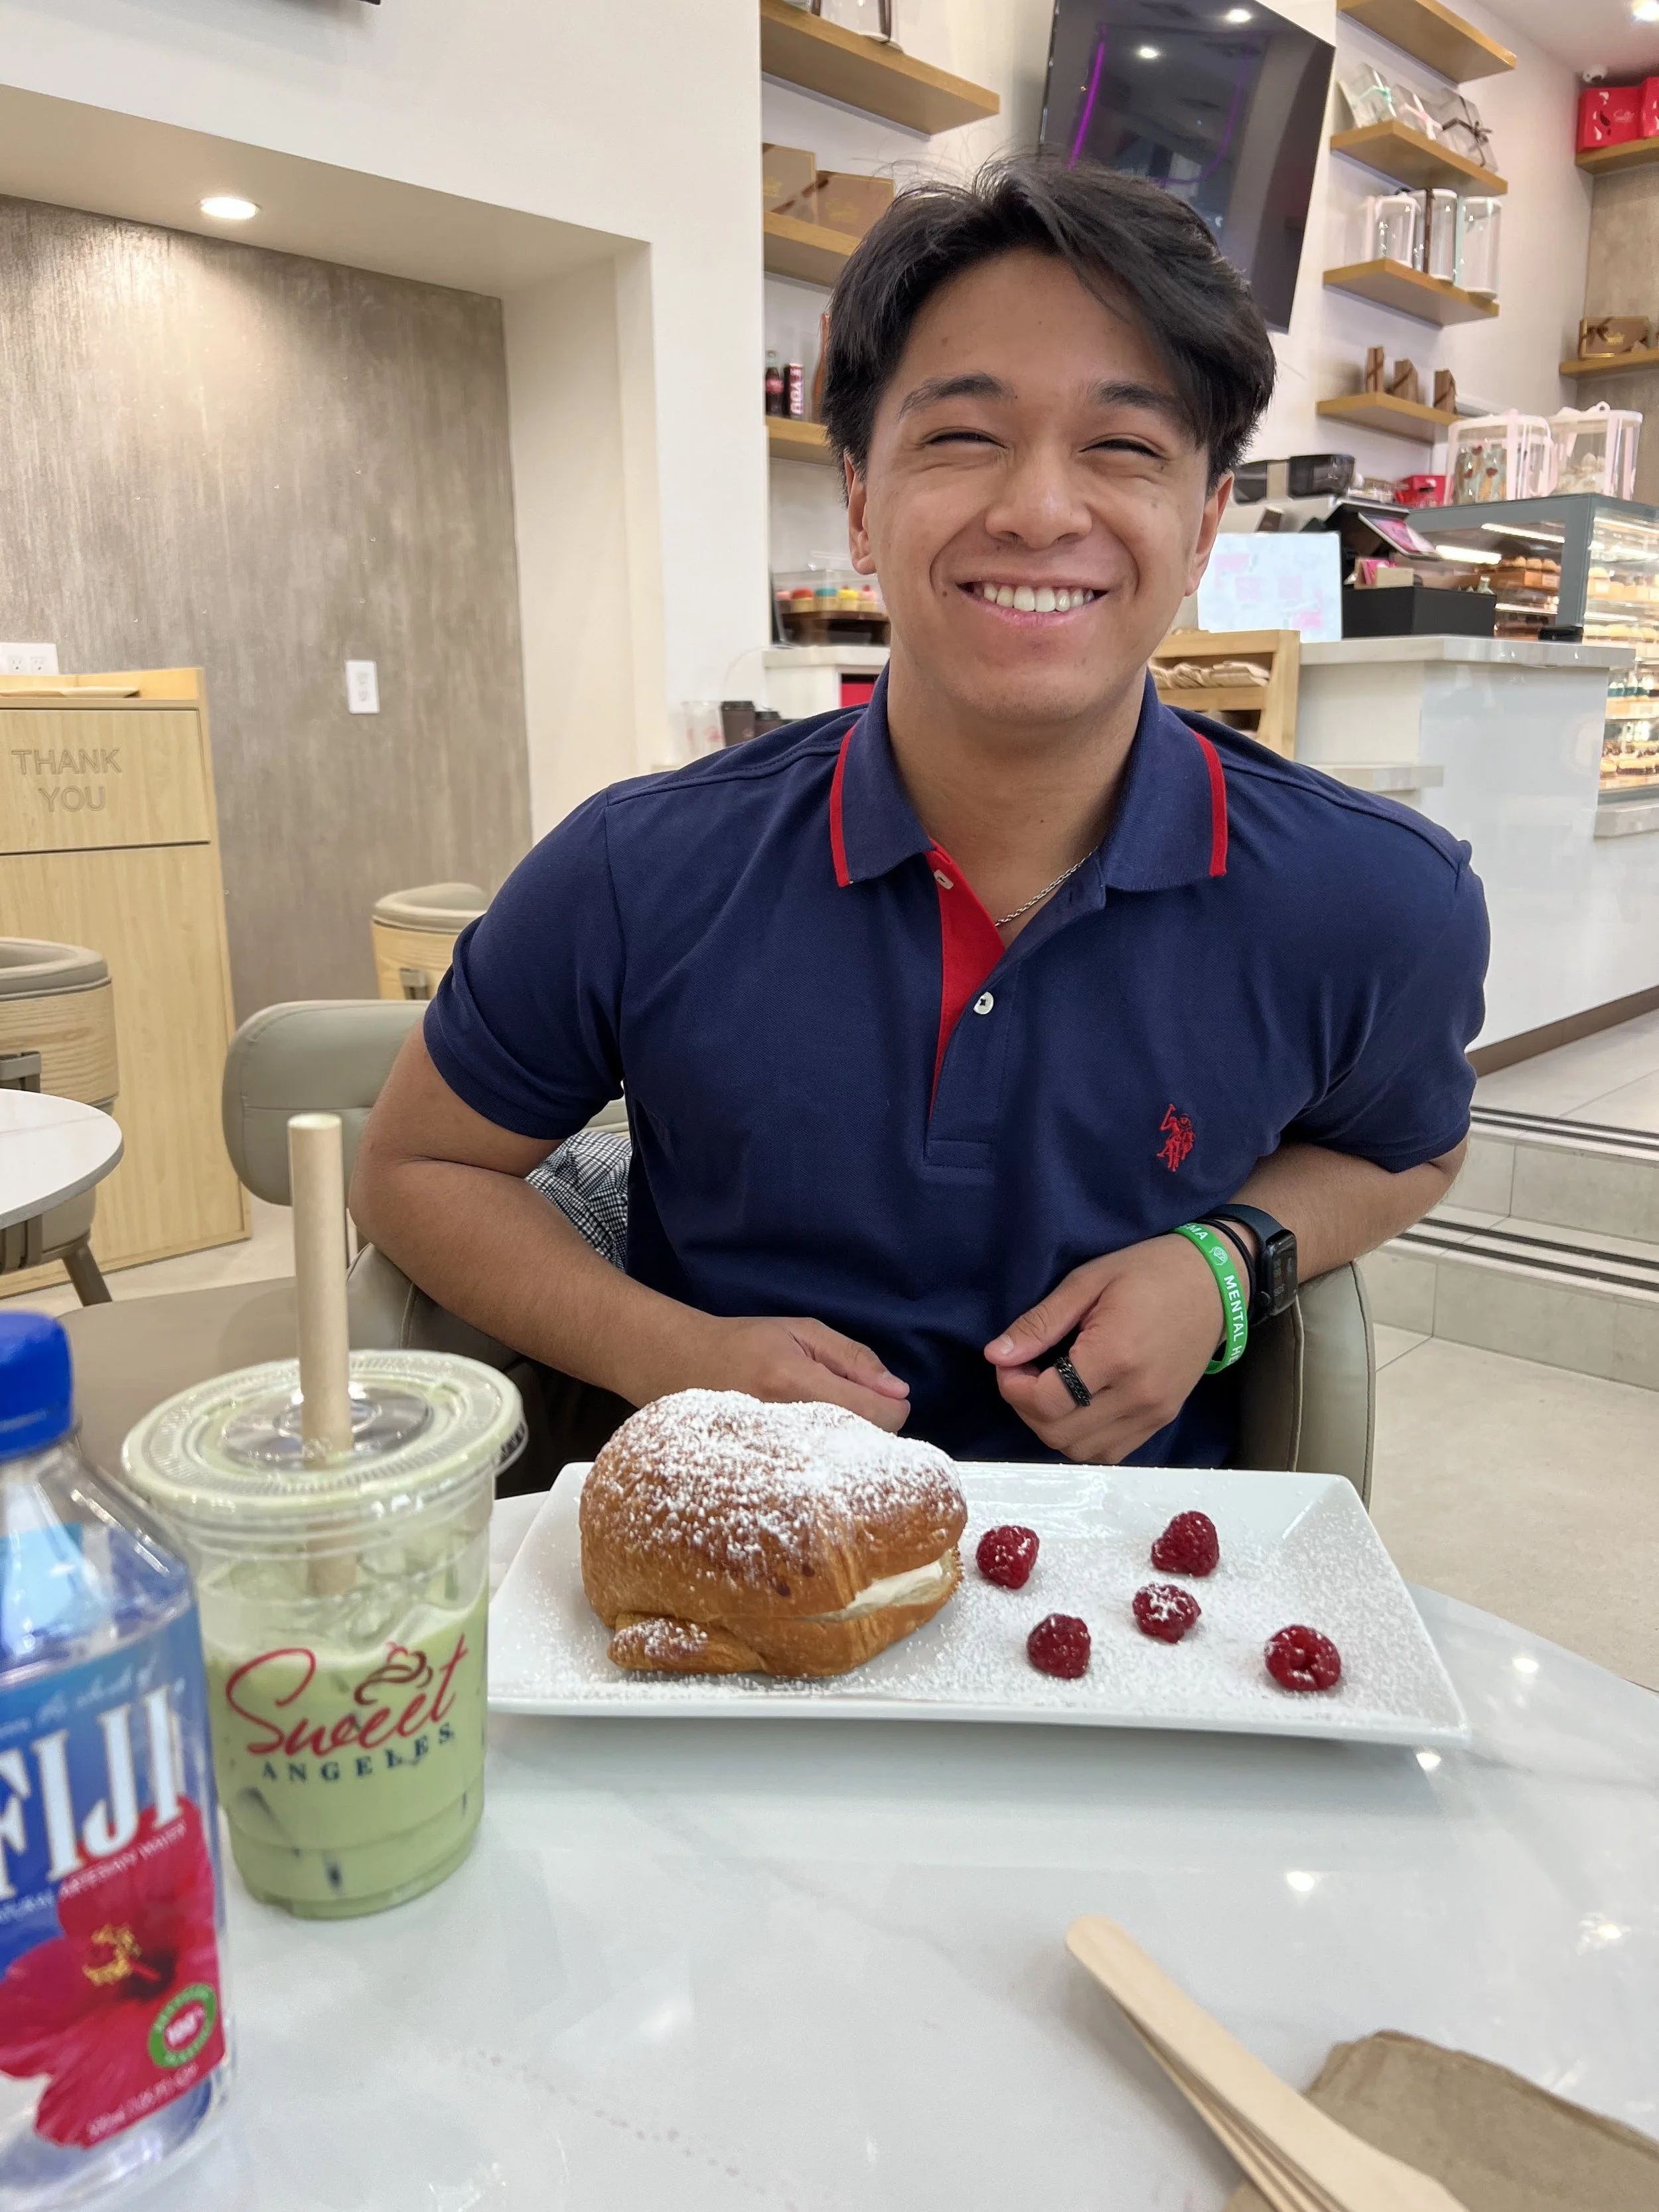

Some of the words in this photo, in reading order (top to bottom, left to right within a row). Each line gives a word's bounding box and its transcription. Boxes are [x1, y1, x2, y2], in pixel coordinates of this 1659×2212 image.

[11, 747, 123, 775] THANK
[38, 785, 106, 813] YOU
[1224, 1274, 1244, 1342] MENTAL
[226, 1633, 469, 1757] Sweet
[262, 1722, 455, 1783] ANGELES
